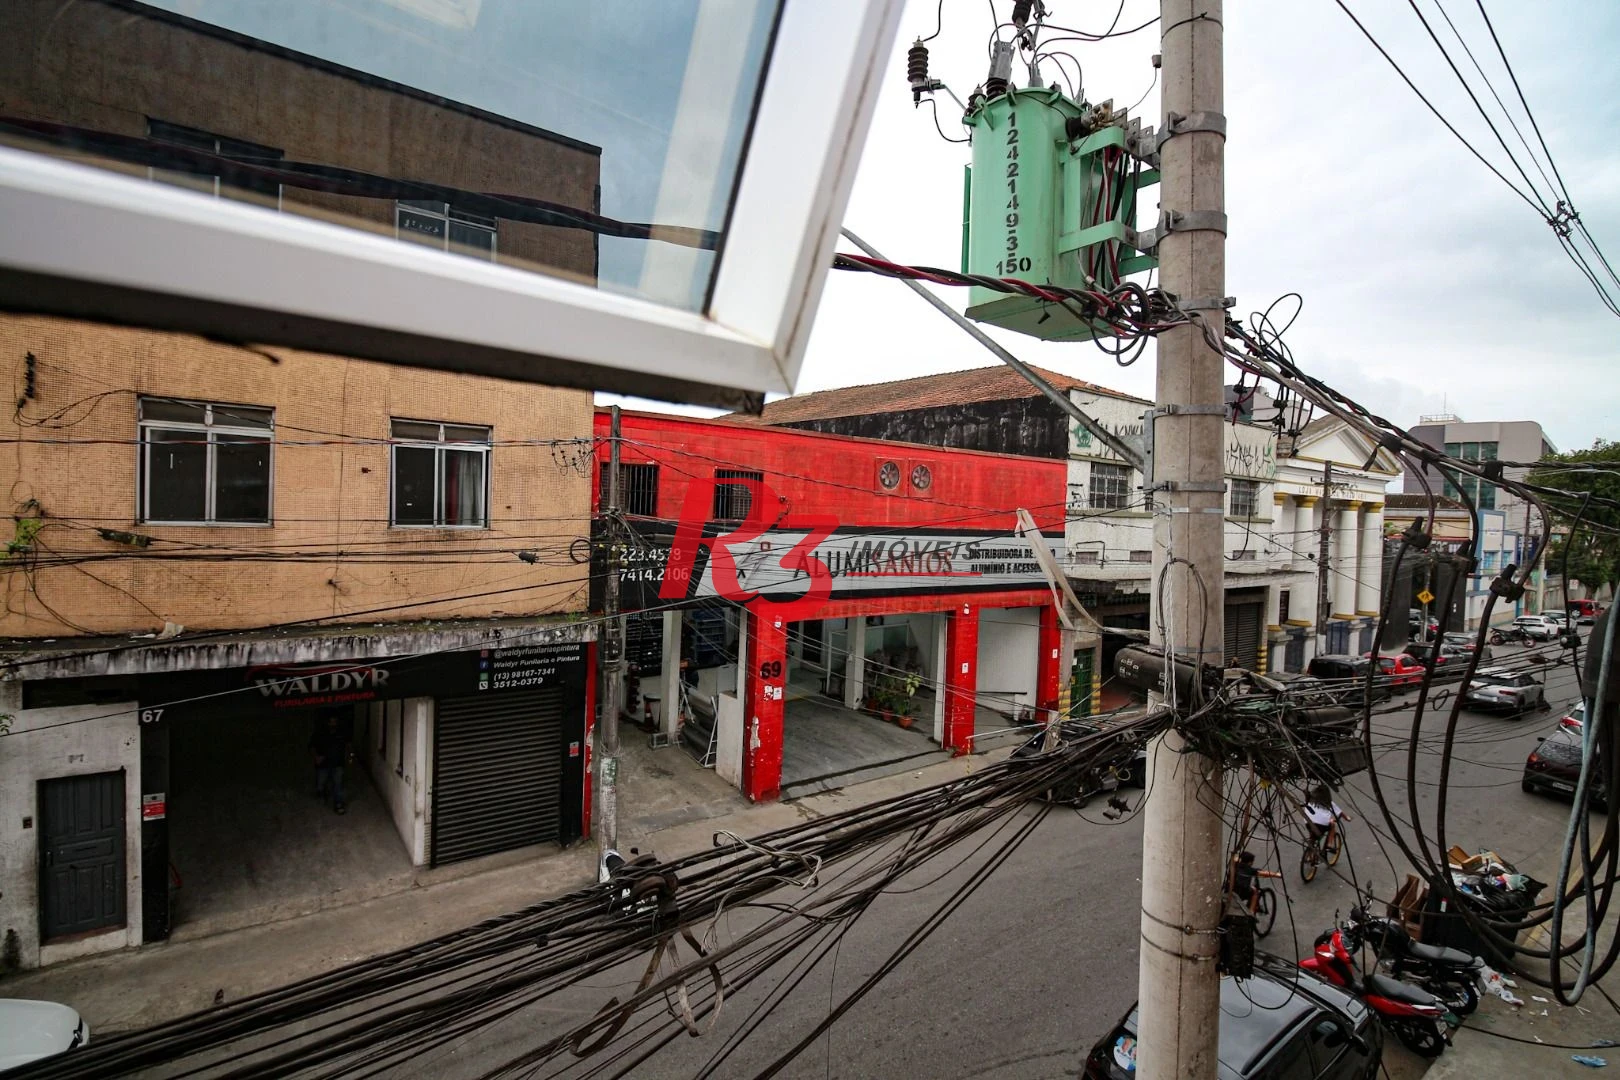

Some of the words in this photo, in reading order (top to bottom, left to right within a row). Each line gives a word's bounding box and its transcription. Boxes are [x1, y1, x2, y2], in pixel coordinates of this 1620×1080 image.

[996, 257, 1031, 275] 150
[969, 548, 1022, 560] DISTRIBUIDORA
[620, 567, 690, 582] 7414.2106
[493, 661, 518, 669] Waldyr
[520, 658, 549, 666] Funilaria
[557, 655, 580, 663] Pintura
[494, 673, 510, 681] (13)
[512, 668, 555, 678] 98167-7341
[761, 661, 782, 679] 69
[255, 667, 390, 697] WALDYR
[493, 677, 544, 689] 3512-0379
[142, 709, 164, 723] 67
